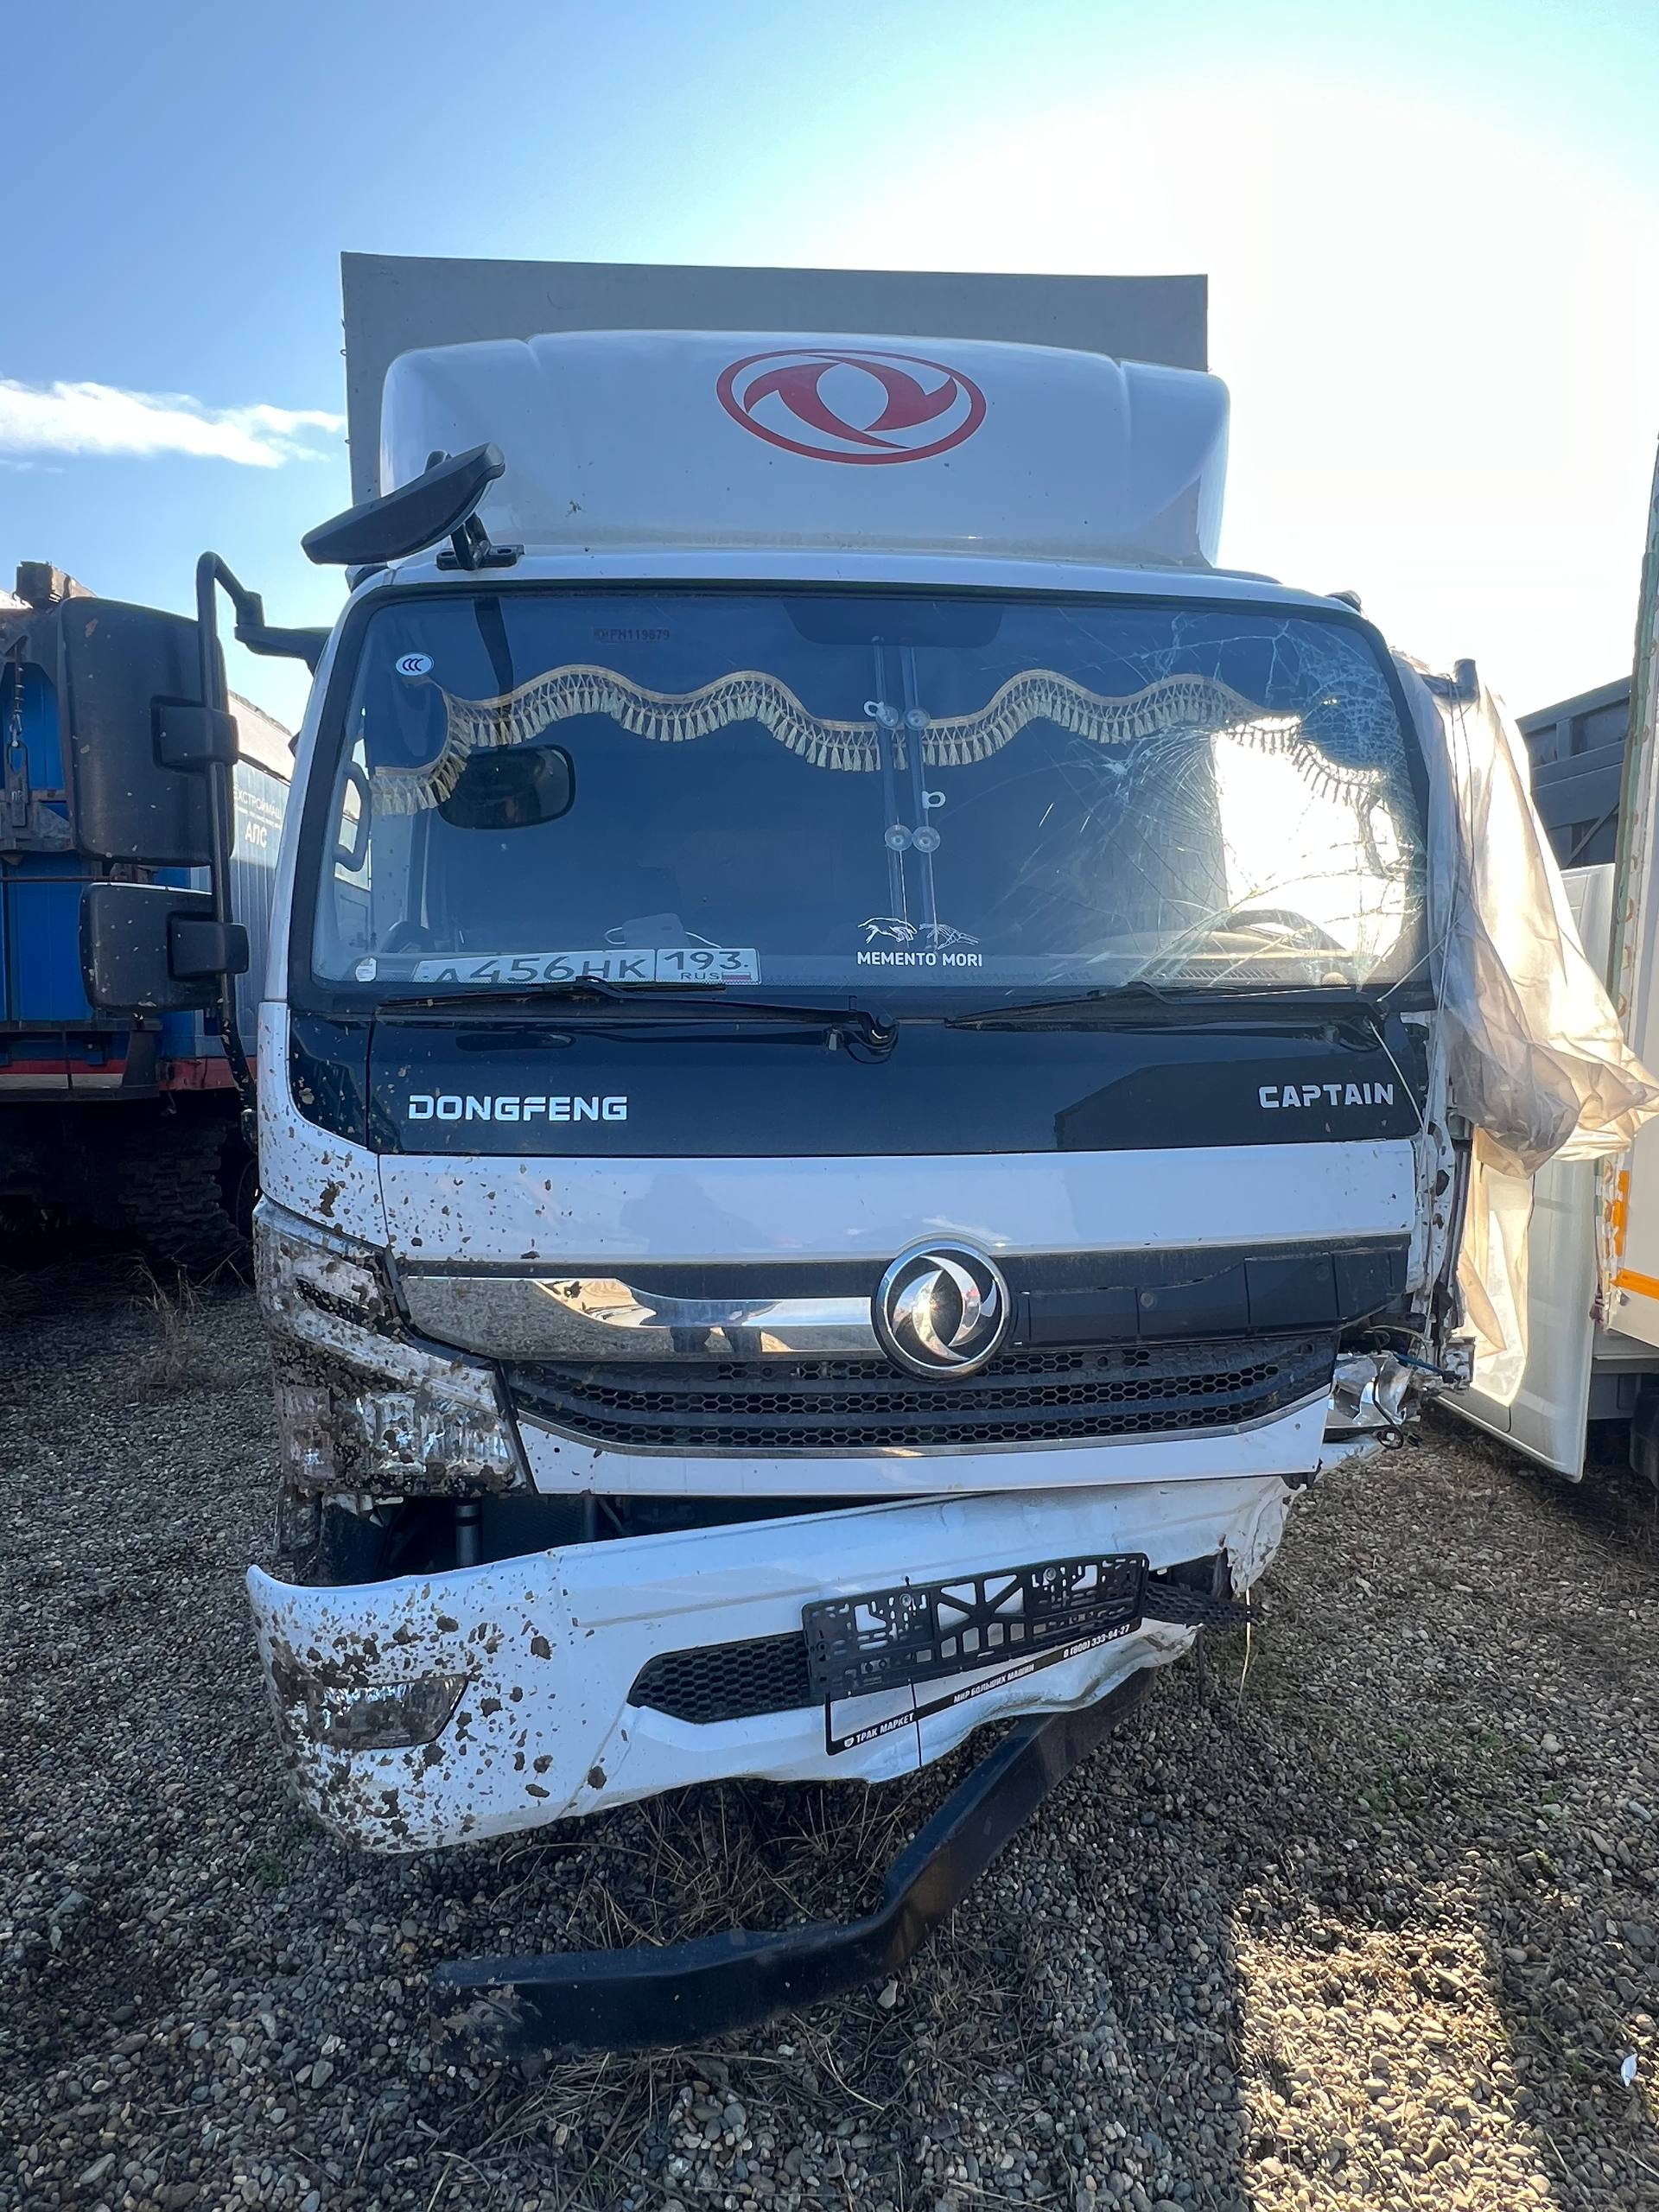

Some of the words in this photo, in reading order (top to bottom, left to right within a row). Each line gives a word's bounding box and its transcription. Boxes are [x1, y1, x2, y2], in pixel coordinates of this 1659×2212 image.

[245, 820, 267, 849] АПС
[664, 951, 741, 969] 193
[856, 950, 938, 966] MEMENTO
[942, 952, 982, 967] MORI
[680, 972, 720, 981] RUS
[1258, 1083, 1394, 1109] CAPTAIN
[408, 1095, 628, 1122] DONGFENG
[953, 1690, 970, 1703] МИР
[855, 1727, 879, 1744] ТРАК
[880, 1712, 914, 1734] МАРКЕТ
